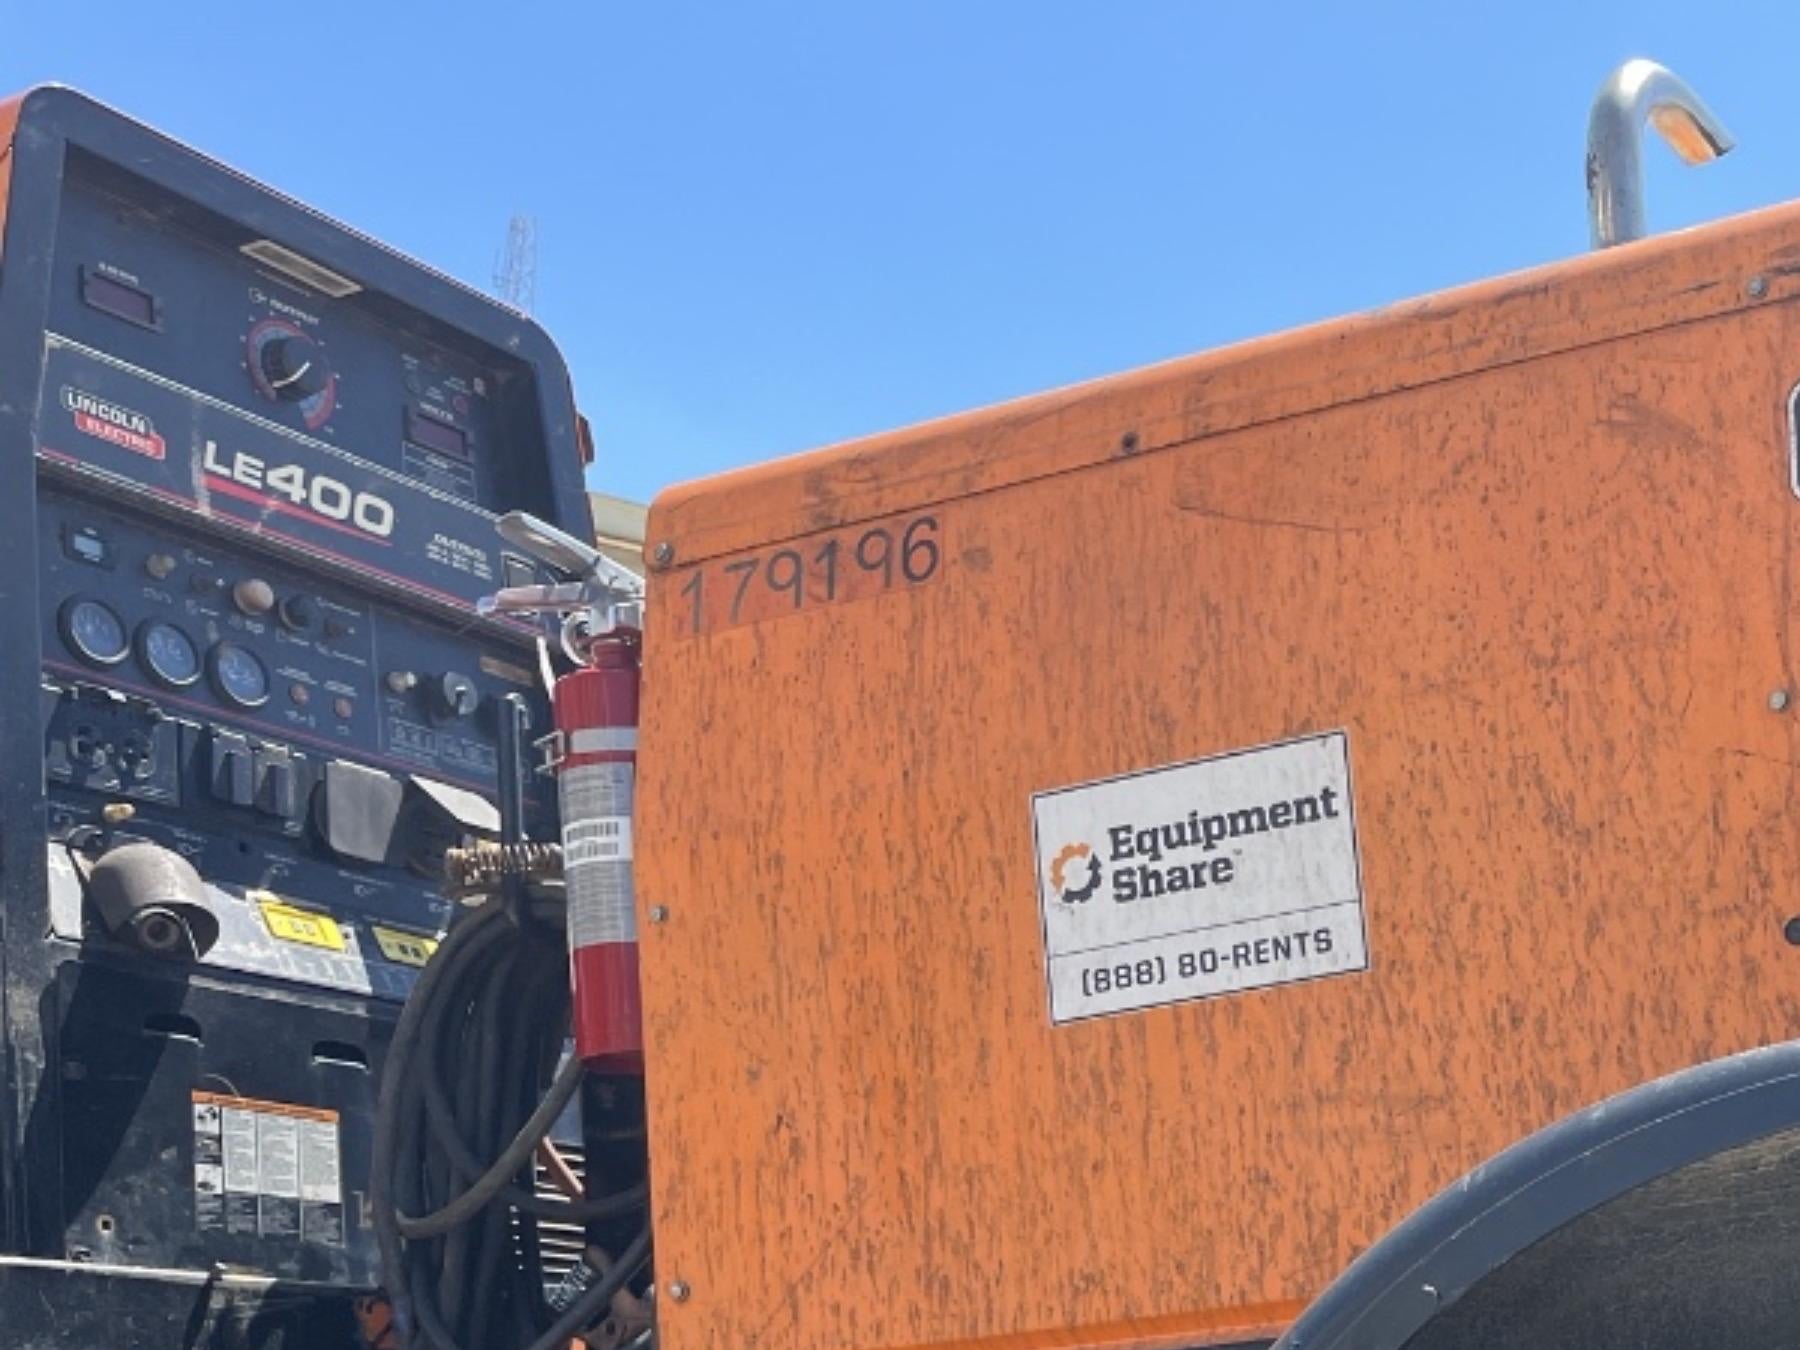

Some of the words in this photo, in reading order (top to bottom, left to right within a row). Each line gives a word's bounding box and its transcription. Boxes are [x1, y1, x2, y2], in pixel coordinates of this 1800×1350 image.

[67, 390, 146, 436] LINCOLN
[201, 438, 396, 537] LE400
[679, 515, 940, 633] 179196
[1107, 785, 1339, 861] Equipment
[1111, 855, 1235, 904] Share
[1081, 956, 1166, 996] (888)
[1177, 928, 1333, 979] 80-RENTS
